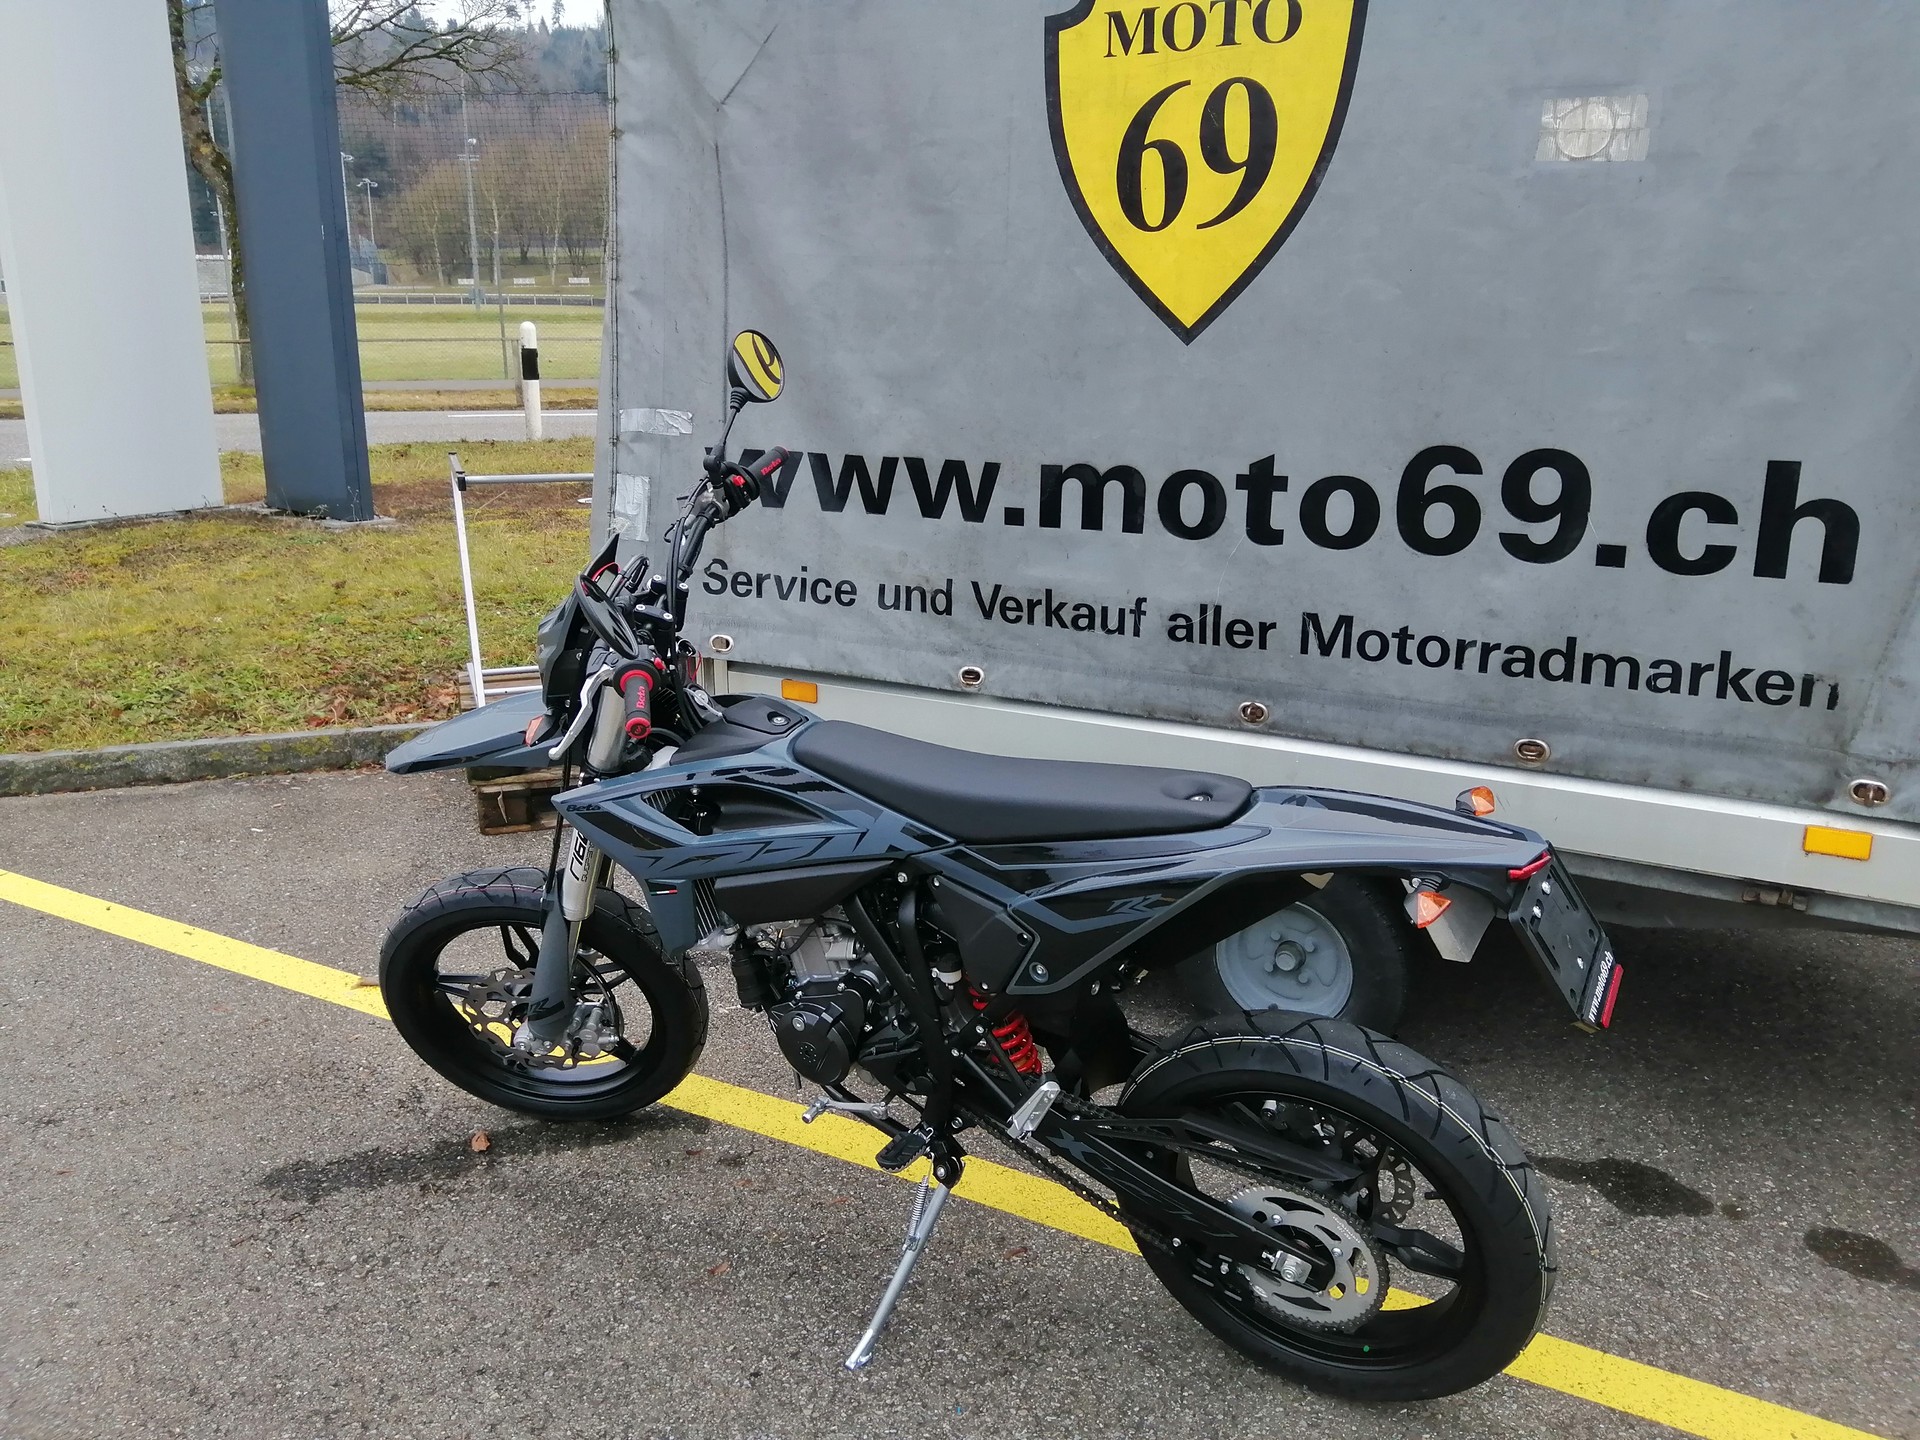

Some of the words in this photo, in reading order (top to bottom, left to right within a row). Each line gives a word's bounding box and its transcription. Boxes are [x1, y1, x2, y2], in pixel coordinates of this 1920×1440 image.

[1103, 0, 1303, 58] MOTO
[1116, 76, 1278, 233] 69
[702, 558, 858, 607] Service
[877, 578, 954, 617] und
[970, 580, 1148, 638] Verkauf
[1166, 603, 1278, 651] aller
[1299, 611, 1840, 711] Motorradmarken
[566, 803, 601, 813] Beta
[1588, 950, 1614, 1023] www.moto69.ch
